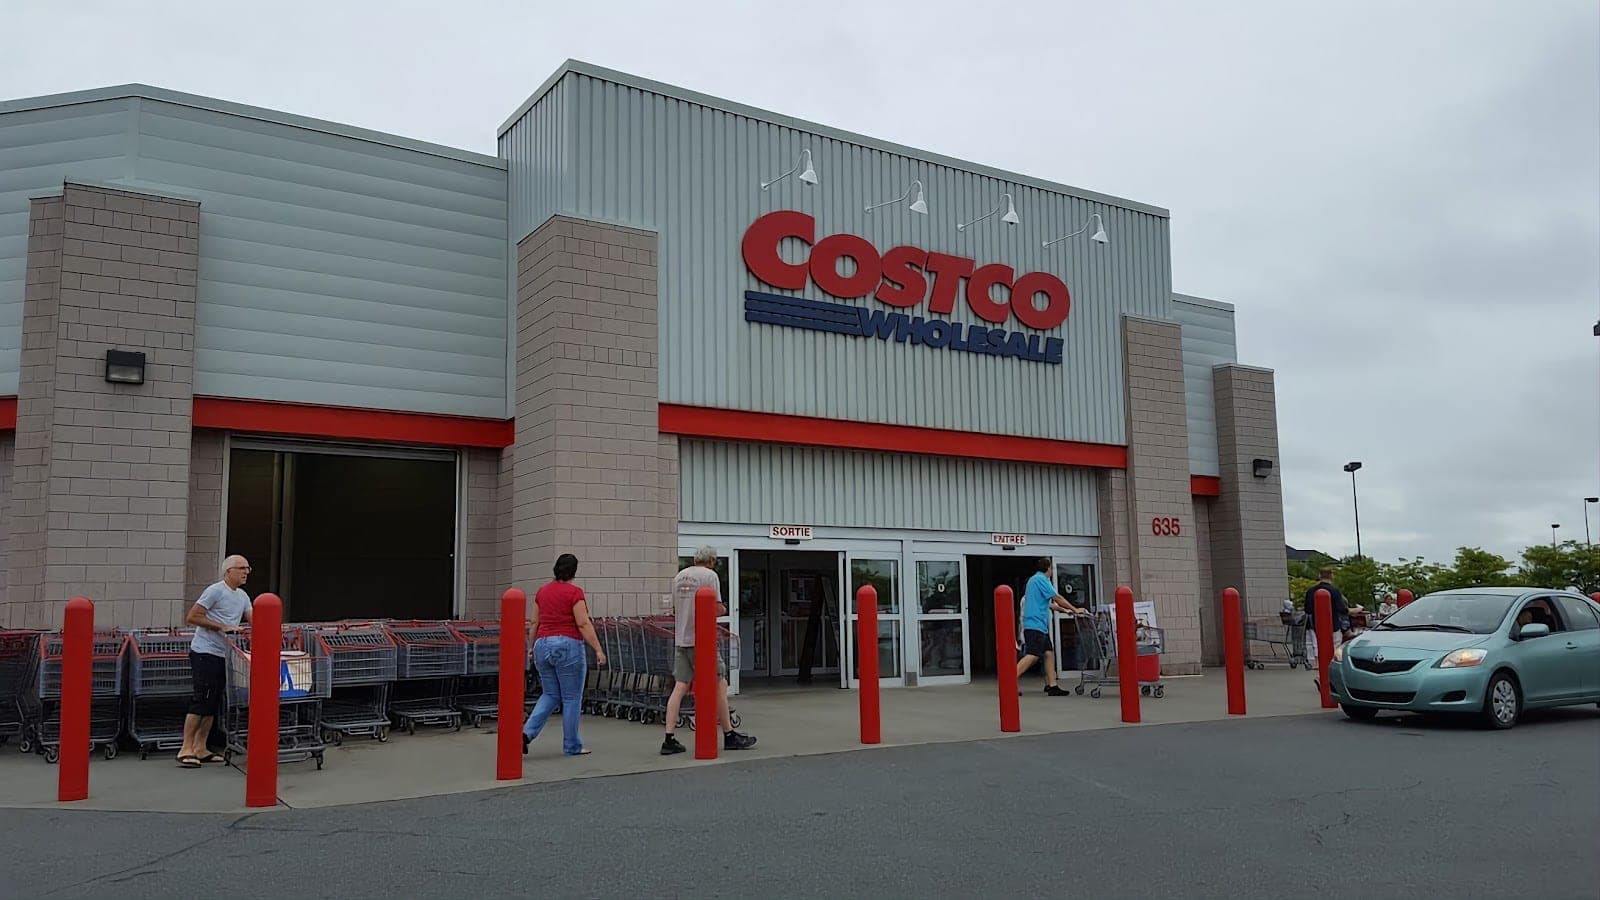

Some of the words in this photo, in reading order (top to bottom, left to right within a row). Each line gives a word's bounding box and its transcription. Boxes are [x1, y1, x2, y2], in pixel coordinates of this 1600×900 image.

[741, 210, 1071, 330] COSTCO
[857, 307, 1064, 364] WHOLESALE
[772, 526, 811, 537] SORTIE
[1152, 517, 1180, 536] 635
[993, 534, 1025, 544] ENTRÉE
